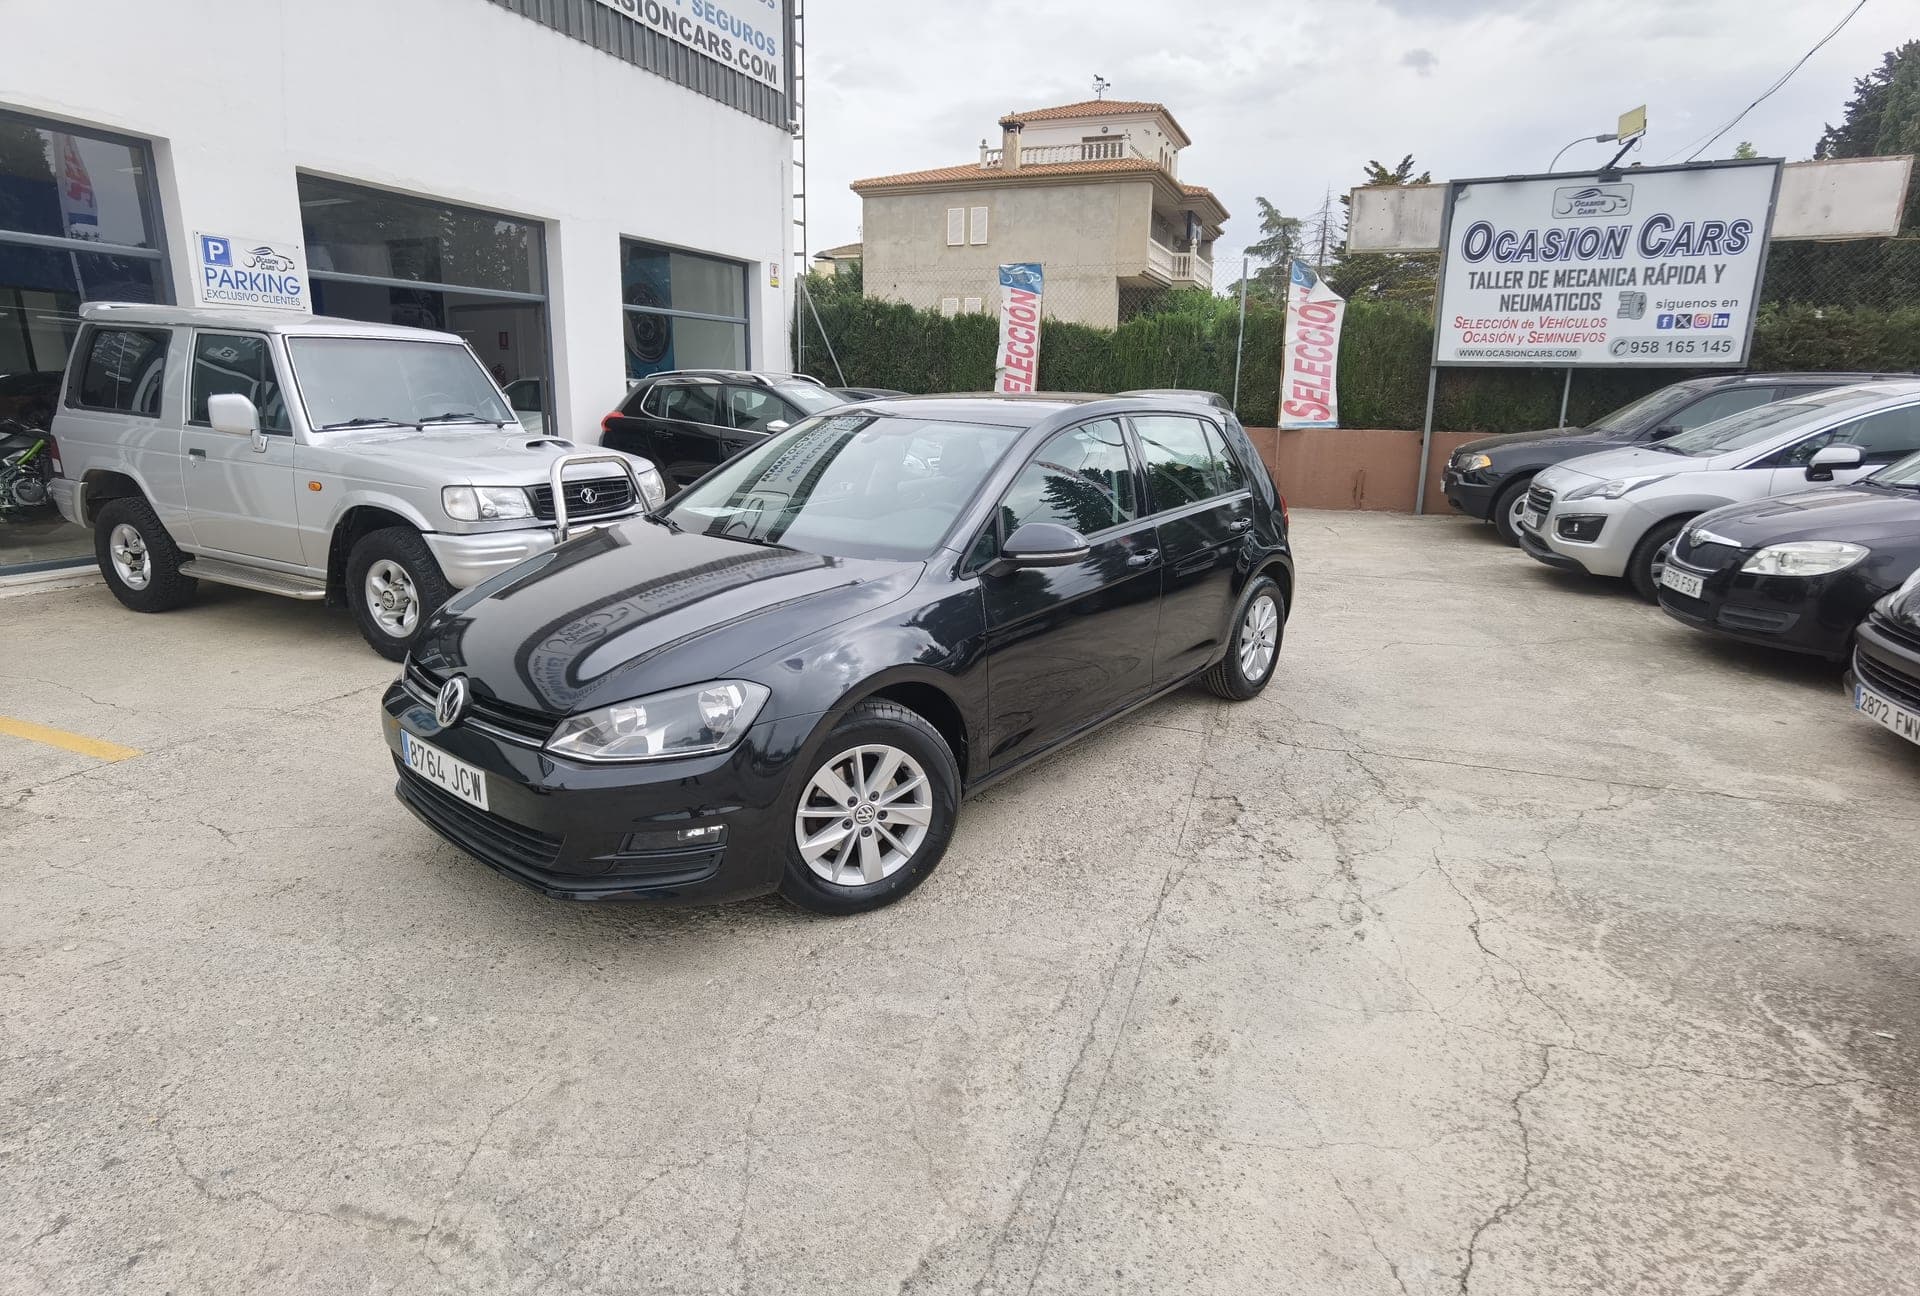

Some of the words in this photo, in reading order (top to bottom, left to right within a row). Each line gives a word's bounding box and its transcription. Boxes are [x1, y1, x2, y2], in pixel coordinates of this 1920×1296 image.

[614, 0, 777, 84] SIONCARS.COM
[691, 0, 776, 57] SEGUROS
[1461, 220, 1632, 263] OCASION
[1636, 213, 1753, 259] CARS
[204, 267, 301, 296] PARKING
[1468, 270, 1523, 290] TALLER
[1528, 269, 1550, 288] DE
[1552, 266, 1638, 288] MECANICA
[1642, 262, 1706, 286] RÁPIDA
[1713, 263, 1727, 284] Y
[206, 289, 259, 303] EXCLUSIVO
[261, 294, 301, 306] CLIENTES
[1499, 292, 1602, 313] NEUMATICOS
[1721, 299, 1738, 308] en
[1454, 316, 1519, 329] SELECCIÓN
[1522, 319, 1534, 329] de
[1539, 316, 1607, 329] VEHÍCULOS
[1003, 287, 1037, 393] ELECCIÓN
[1462, 331, 1516, 344] OCASIÓN
[1516, 335, 1524, 346] y
[1527, 331, 1606, 344] SEMINUEVOS
[1630, 341, 1659, 354] 958
[1666, 341, 1695, 354] 165
[1701, 340, 1731, 353] 145
[1459, 349, 1577, 358] WWW.OCASIONCARS.COM
[1861, 692, 1889, 724] 2872
[410, 740, 446, 784] 8764
[451, 763, 482, 803] JCW
